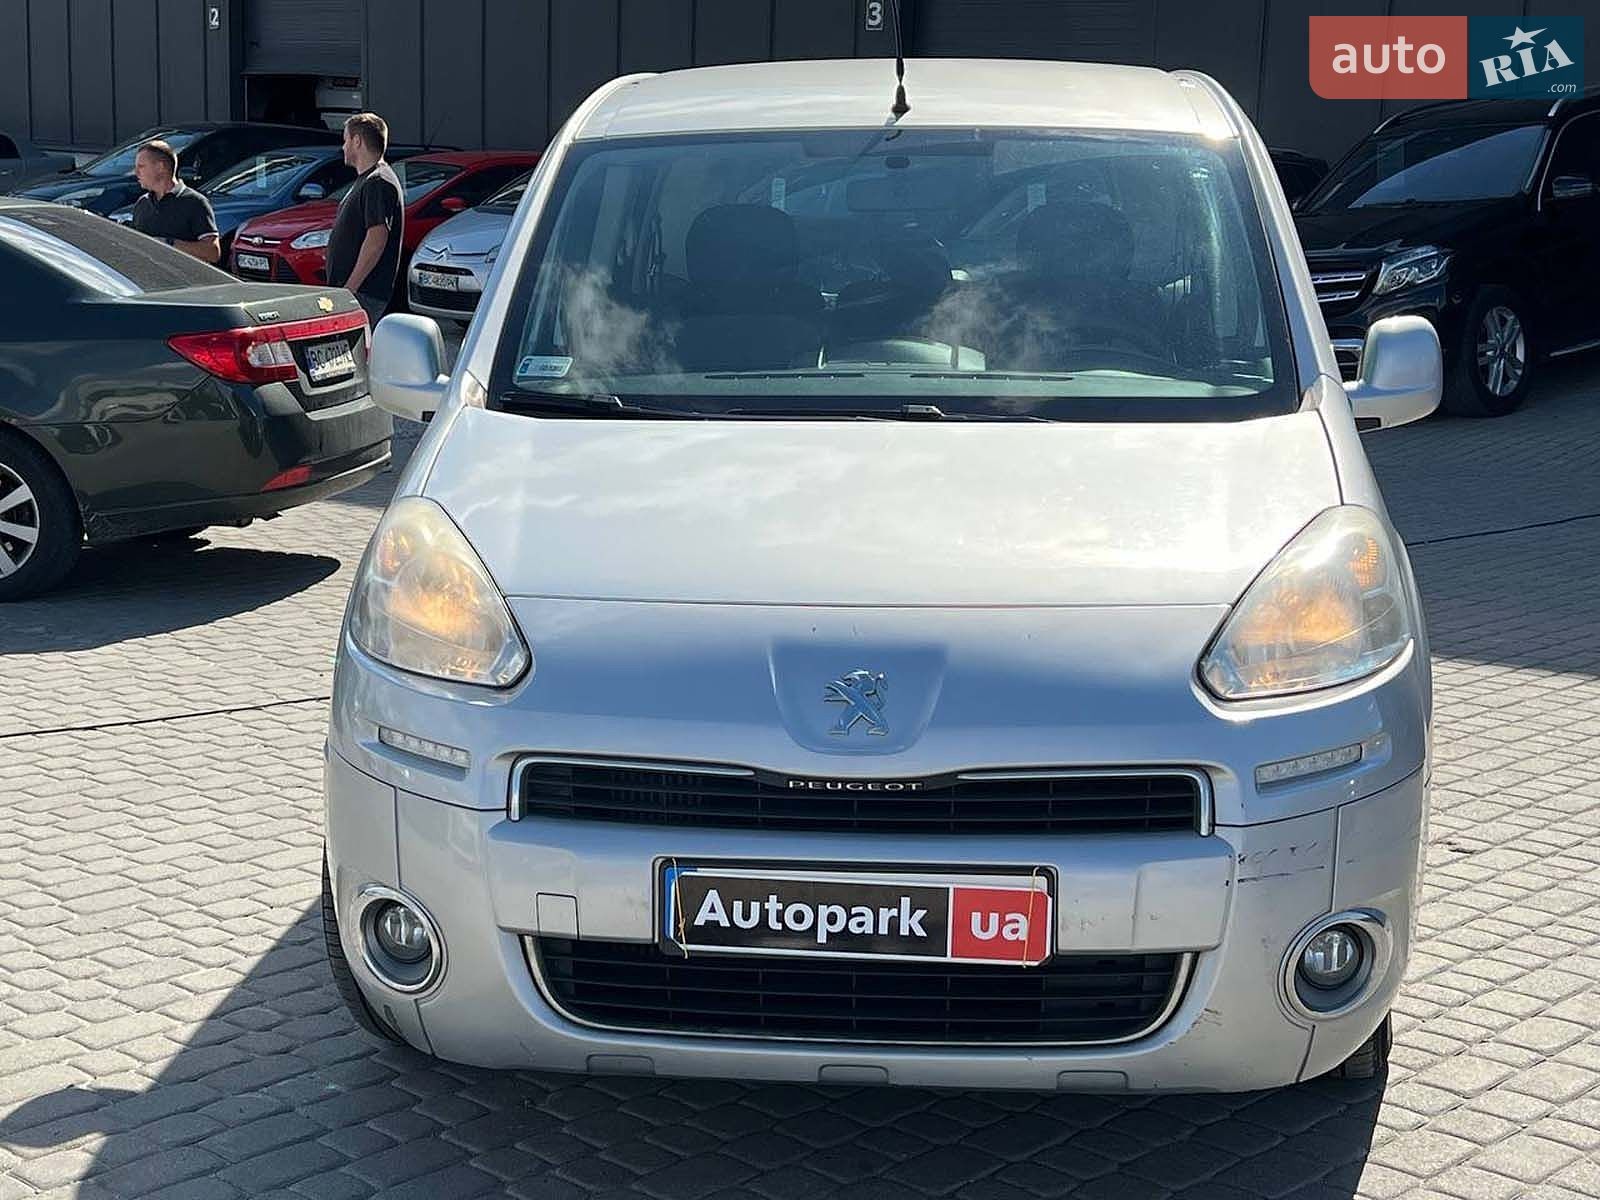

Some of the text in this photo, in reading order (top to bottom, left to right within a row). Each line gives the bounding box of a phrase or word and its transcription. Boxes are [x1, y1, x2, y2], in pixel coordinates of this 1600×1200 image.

[210, 8, 219, 25] 2
[869, 2, 881, 25] 3
[788, 780, 922, 791] PEUGEOT
[693, 888, 1029, 944] Autopark ua
